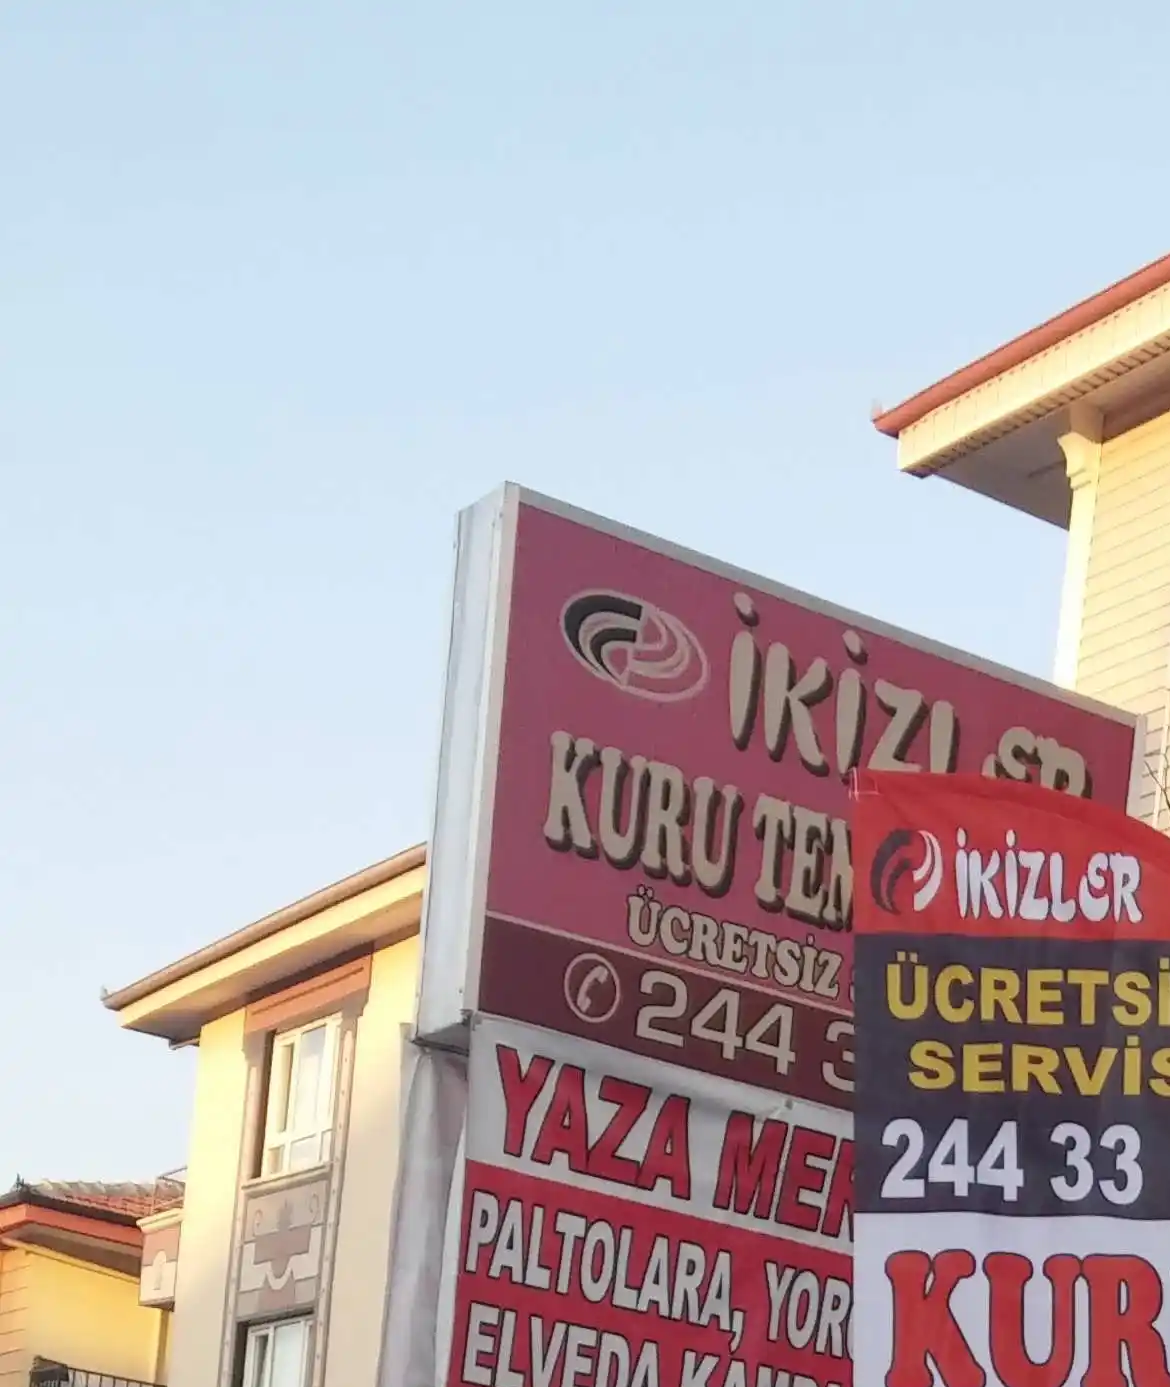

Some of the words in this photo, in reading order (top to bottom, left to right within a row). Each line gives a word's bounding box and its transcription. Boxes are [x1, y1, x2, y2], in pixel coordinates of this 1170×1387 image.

[544, 731, 742, 894] KURU
[956, 827, 1144, 924] İKİZLER
[625, 886, 841, 999] ÜCRETSİZ
[635, 970, 796, 1075] 244
[496, 1043, 692, 1200] YAZA
[880, 1117, 1024, 1202] 244
[1050, 1122, 1143, 1205] 33
[466, 1189, 745, 1354] PALTOLARA,
[764, 1260, 854, 1360] YOR
